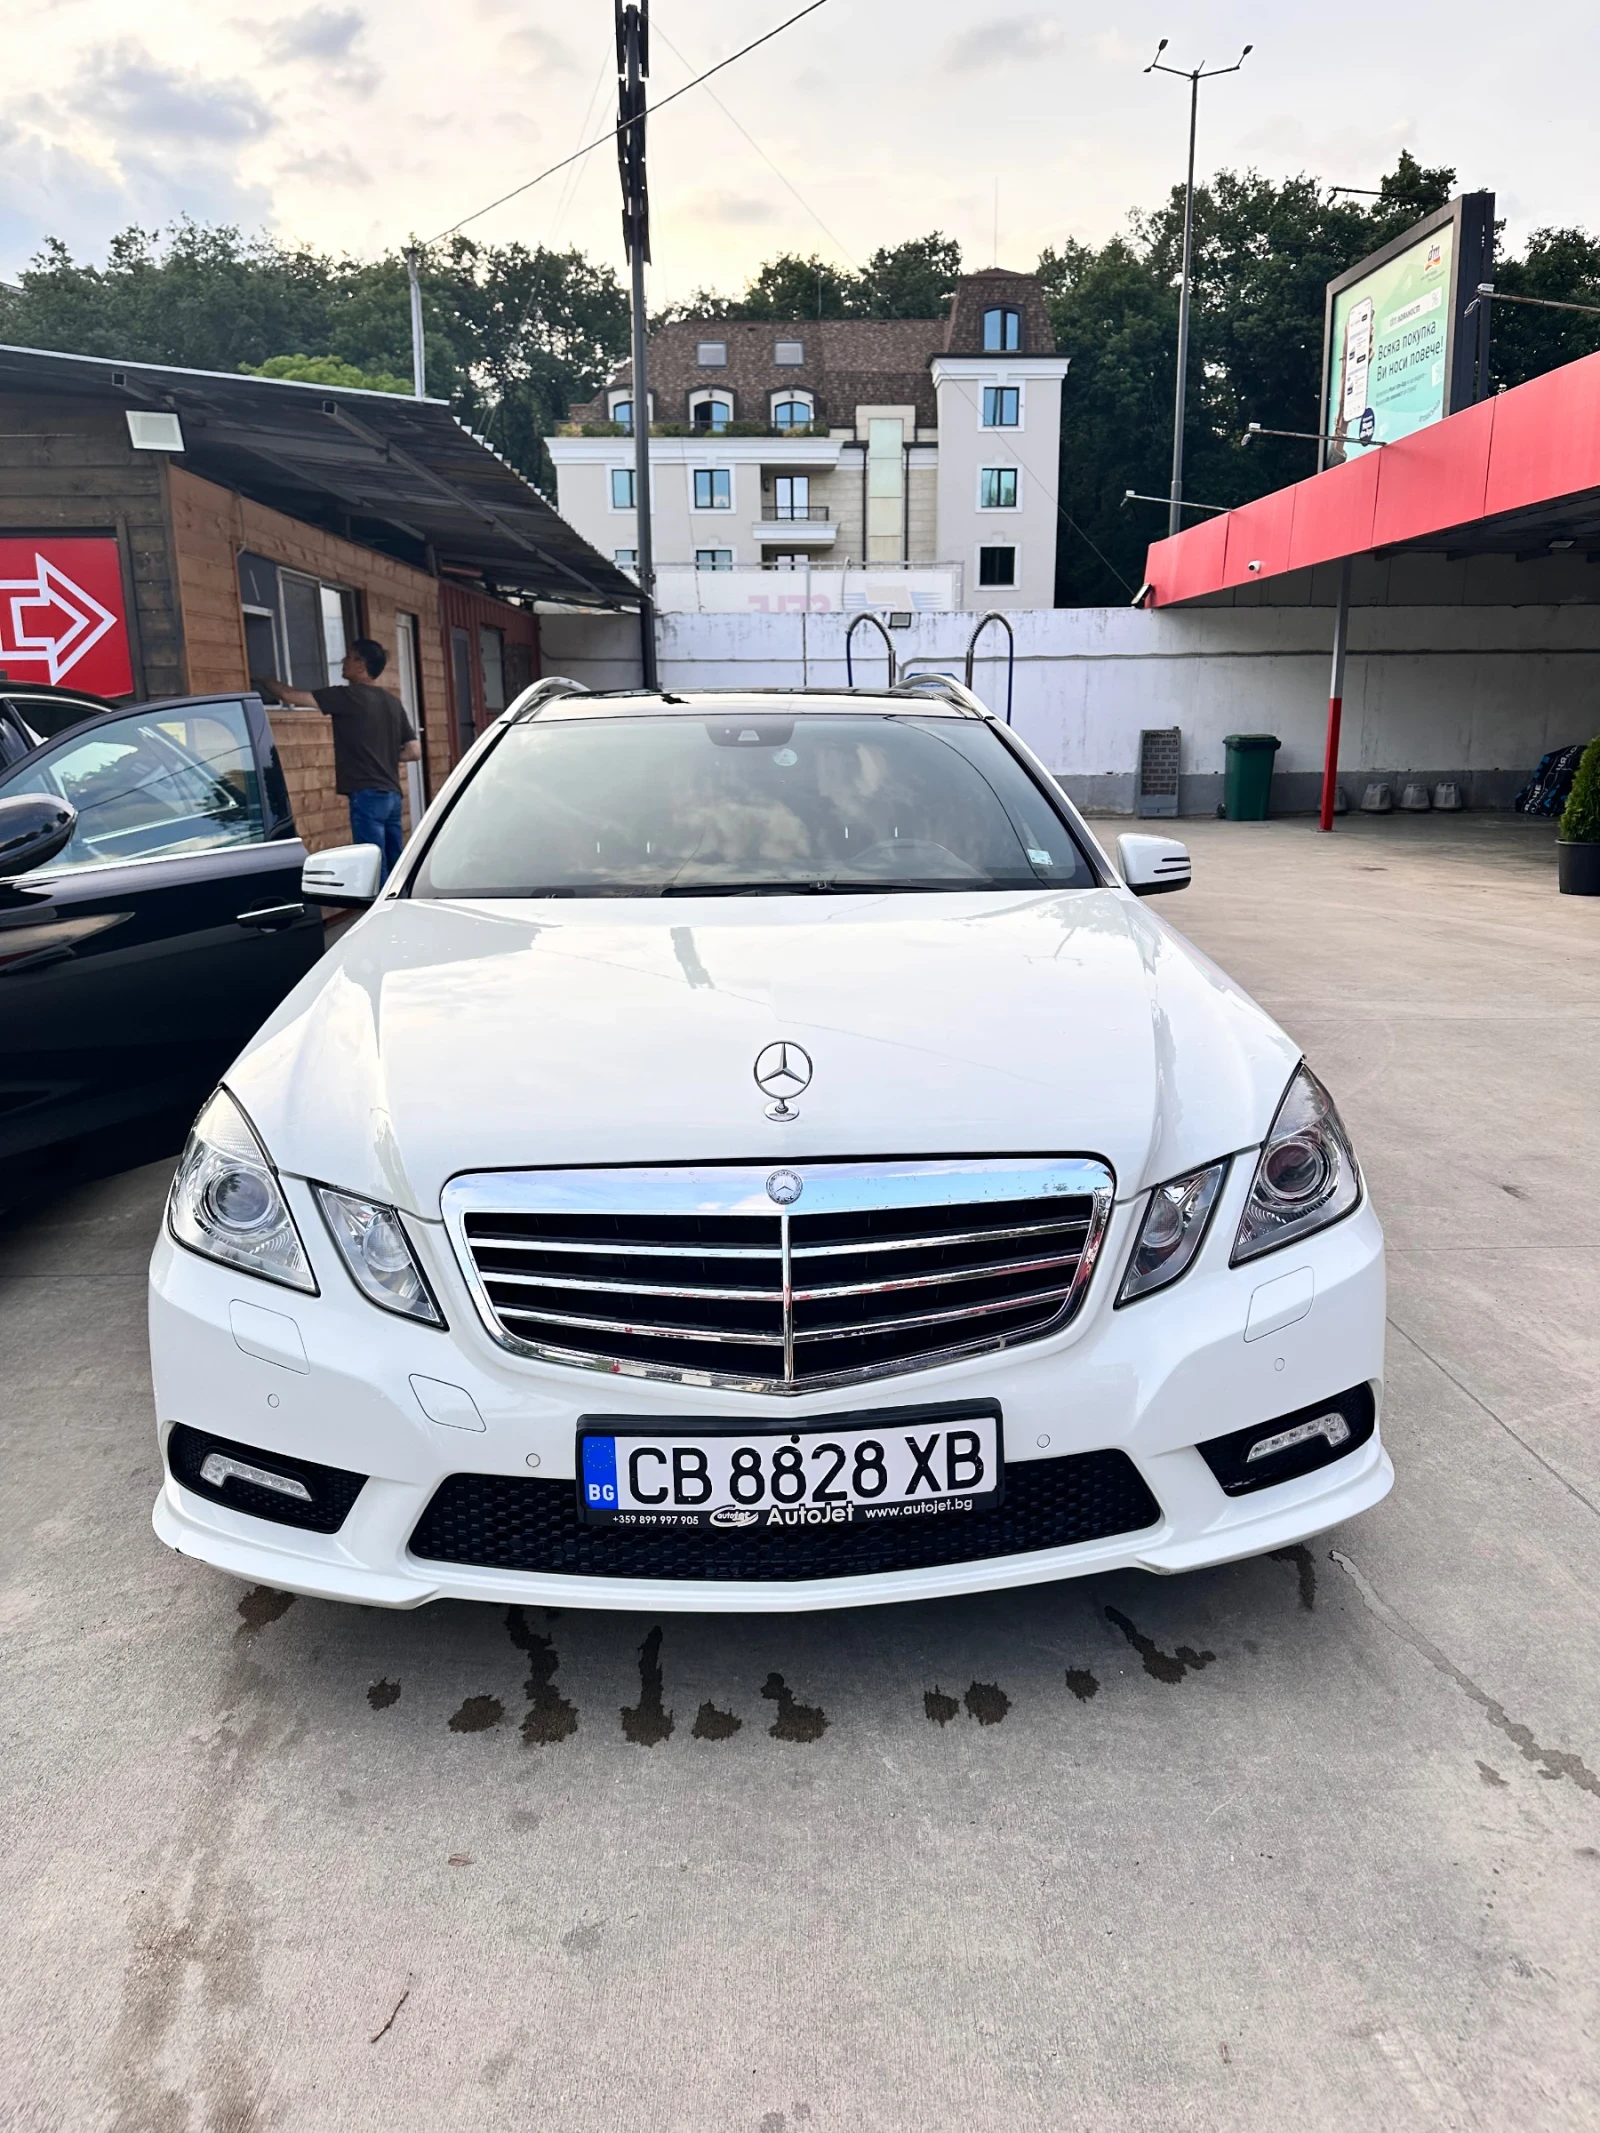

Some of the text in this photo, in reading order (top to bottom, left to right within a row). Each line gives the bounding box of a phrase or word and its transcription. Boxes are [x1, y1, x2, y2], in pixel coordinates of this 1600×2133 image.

[1427, 244, 1440, 261] dm
[1378, 321, 1436, 361] Всяка покупка
[1377, 335, 1444, 381] Ви носи повече!
[629, 1430, 985, 1505] CB 8828 XB
[588, 1484, 615, 1501] BG
[612, 1515, 699, 1525] +359 899 997 905
[766, 1498, 973, 1526] AutoJet www.autojet.bg
